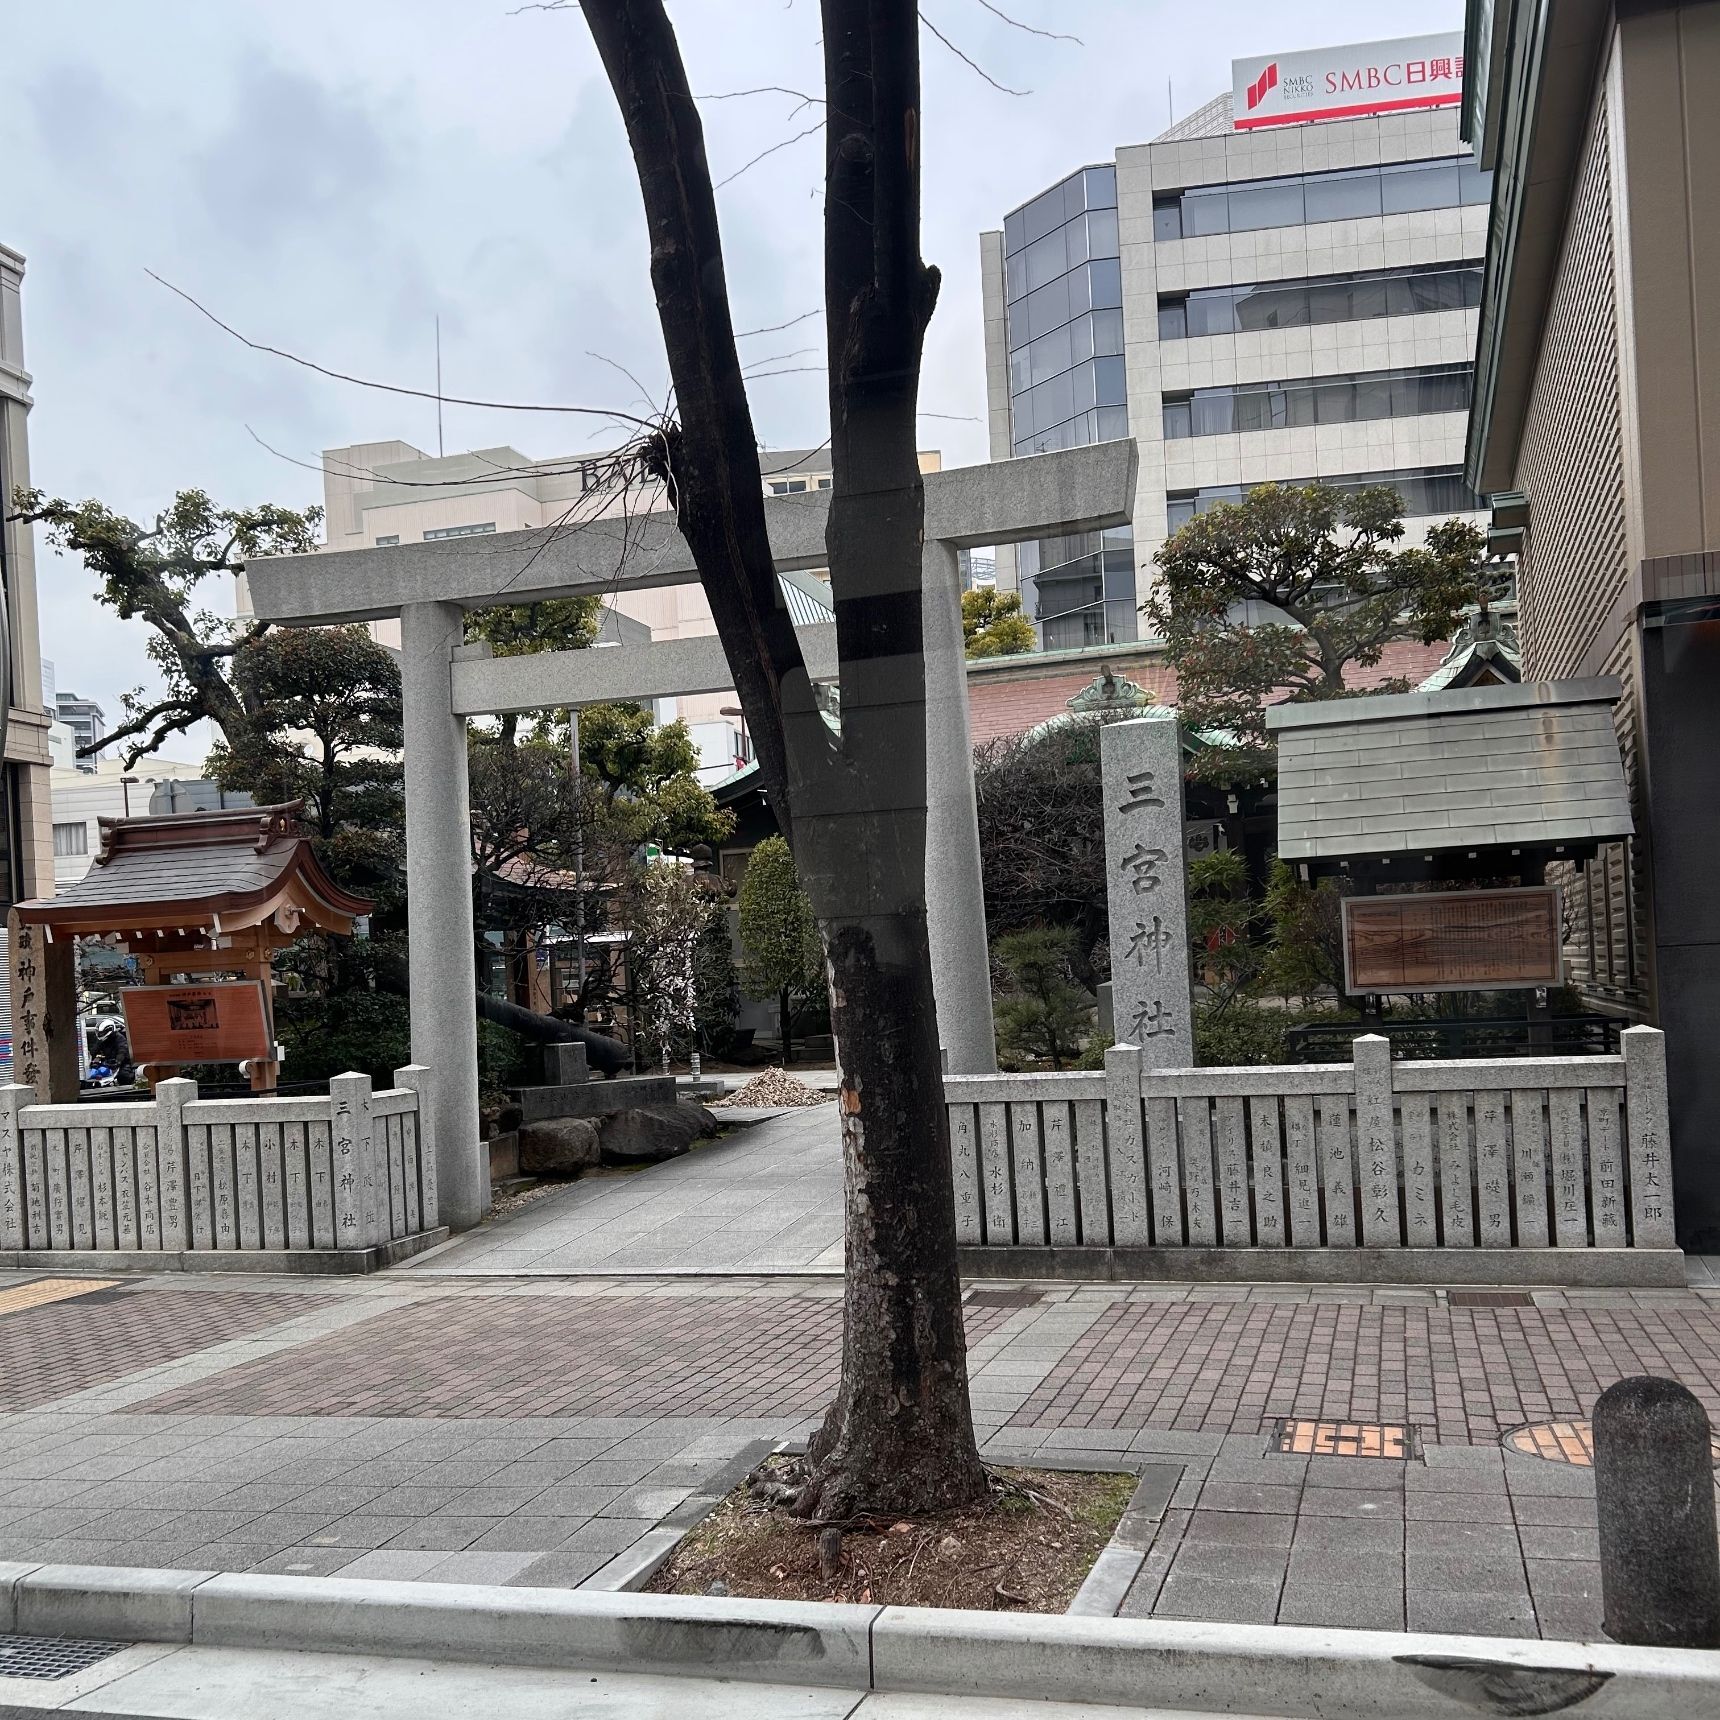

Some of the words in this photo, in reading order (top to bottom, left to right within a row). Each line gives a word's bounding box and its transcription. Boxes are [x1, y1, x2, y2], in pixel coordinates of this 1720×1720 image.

[1283, 75, 1313, 87] SMBC
[1283, 84, 1314, 95] NIKKO
[1117, 771, 1176, 1044] 三宮神社
[1, 1111, 17, 1230] マスヤ株式会社
[336, 1101, 357, 1229] 三宮神社
